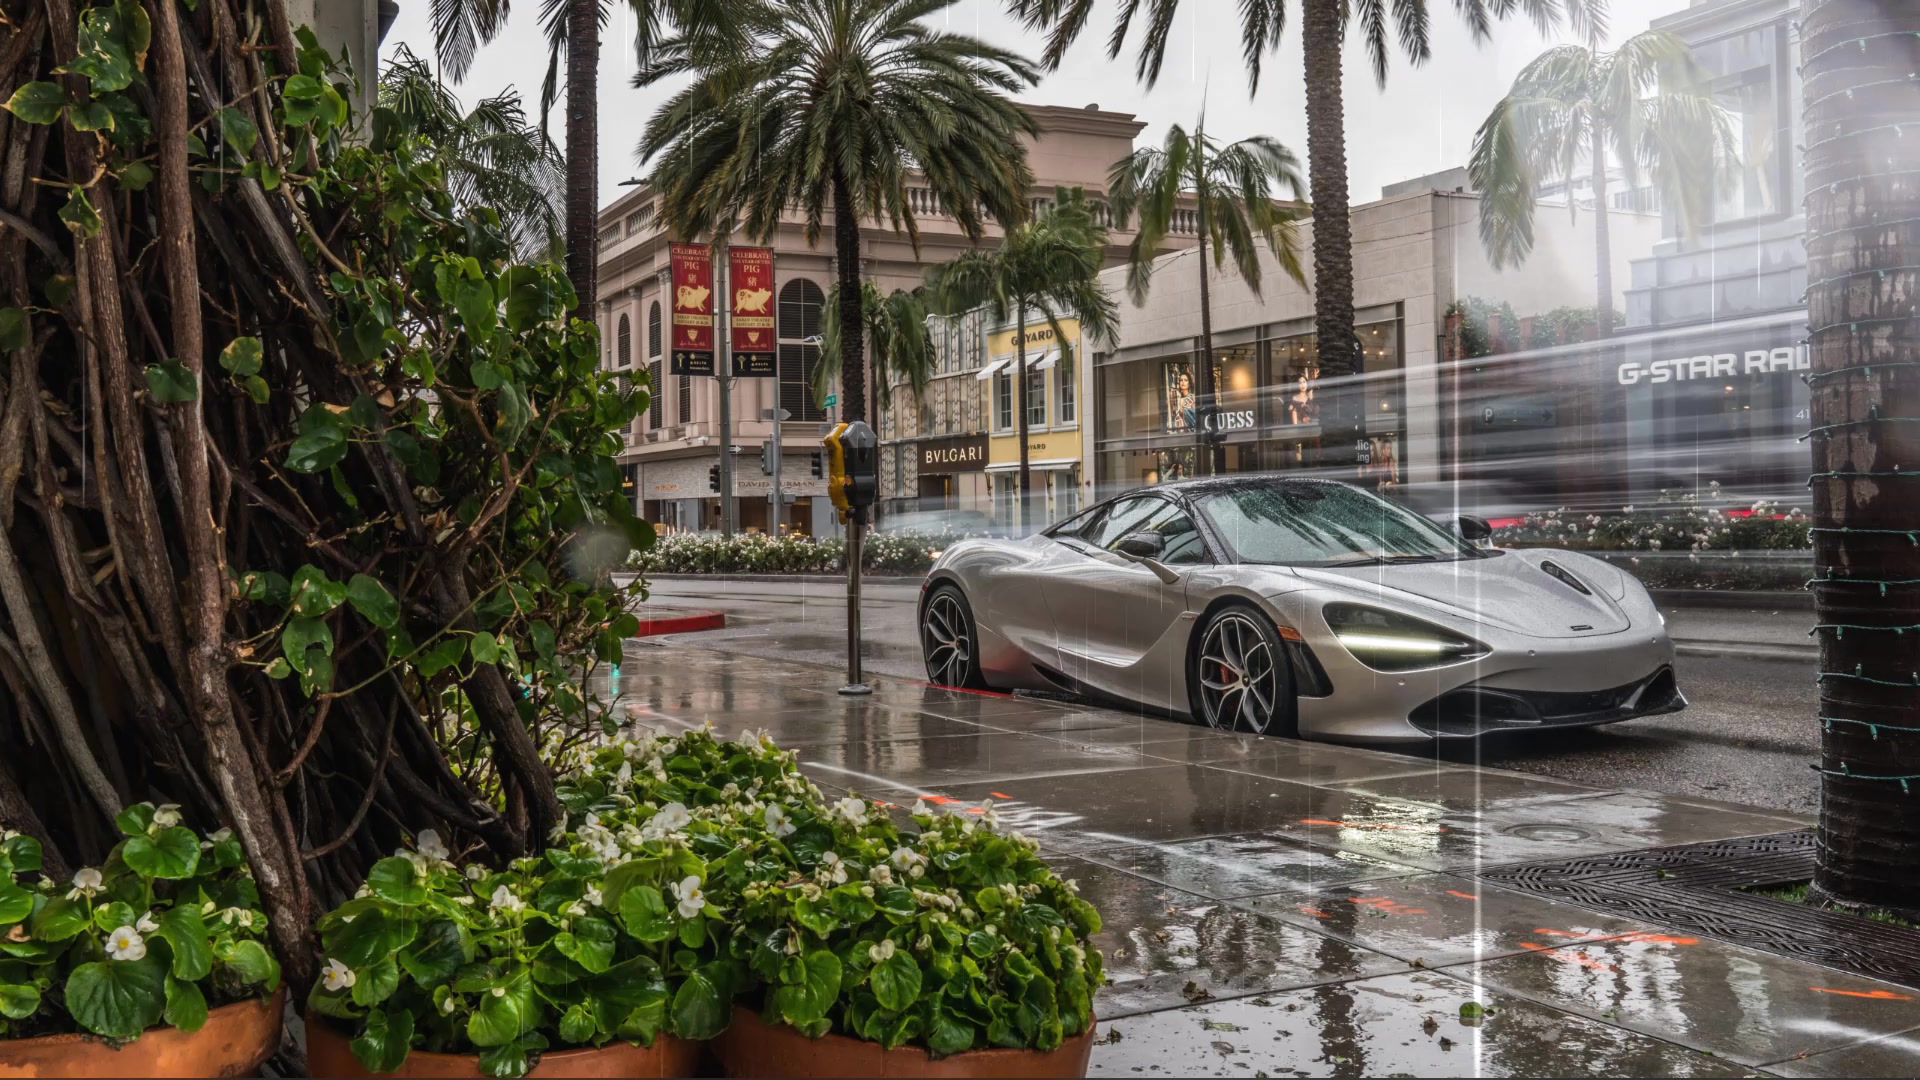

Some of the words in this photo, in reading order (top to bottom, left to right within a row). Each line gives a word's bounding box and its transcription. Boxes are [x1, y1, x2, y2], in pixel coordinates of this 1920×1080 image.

[684, 261, 699, 270] PIG
[743, 264, 760, 273] PIG
[1011, 329, 1053, 346] GYARD
[1618, 353, 1737, 385] G-STAR
[1796, 409, 1810, 420] 41
[926, 446, 982, 463] BVLGARI
